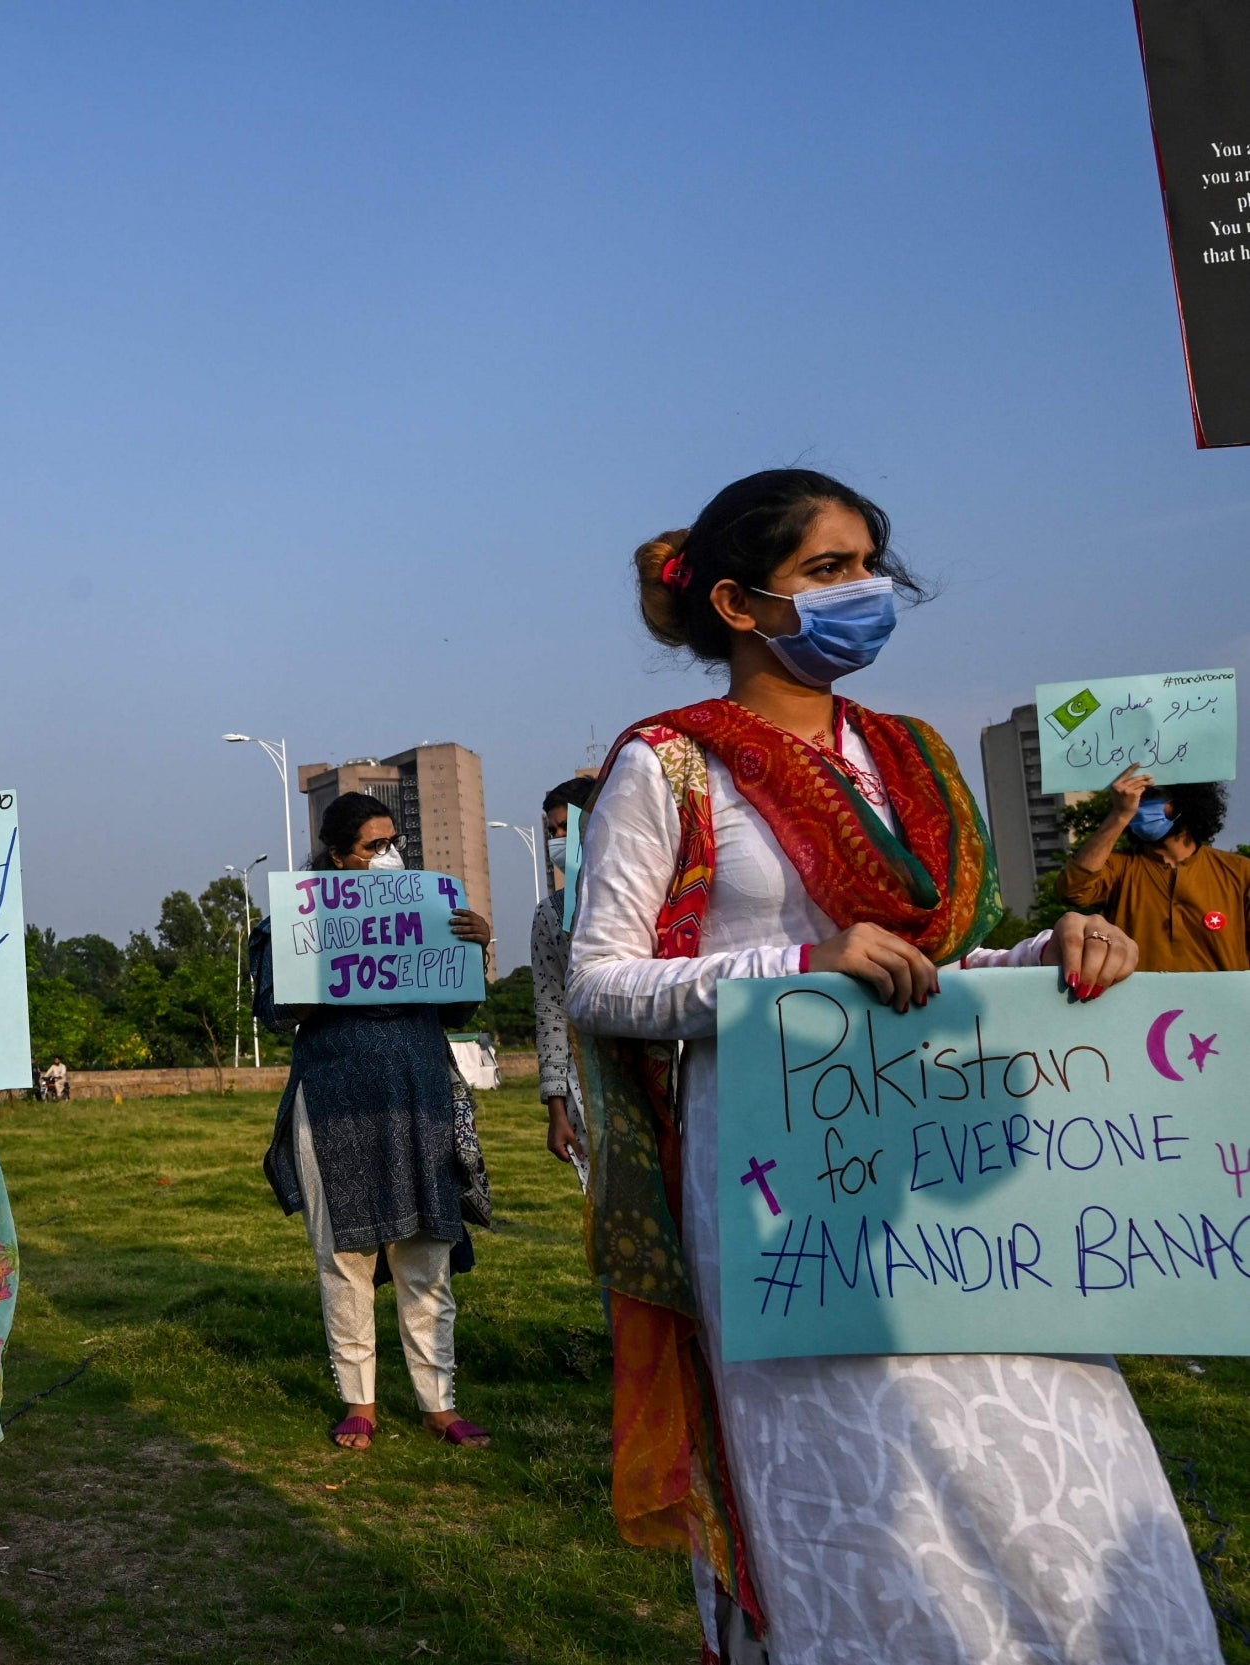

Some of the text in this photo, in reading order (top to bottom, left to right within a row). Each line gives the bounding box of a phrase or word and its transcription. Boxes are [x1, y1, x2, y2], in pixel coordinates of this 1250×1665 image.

[1211, 142, 1242, 158] You
[1202, 171, 1230, 189] you
[1210, 220, 1242, 236] You
[1203, 247, 1235, 264] that
[295, 873, 459, 915] JUSTICE 4
[291, 911, 424, 956] NADEEM
[328, 945, 466, 998] JOSEPH
[776, 989, 1110, 1132] Pakistan
[817, 1113, 1190, 1203] for EVERYONE
[754, 1215, 1052, 1316] #MANDIR
